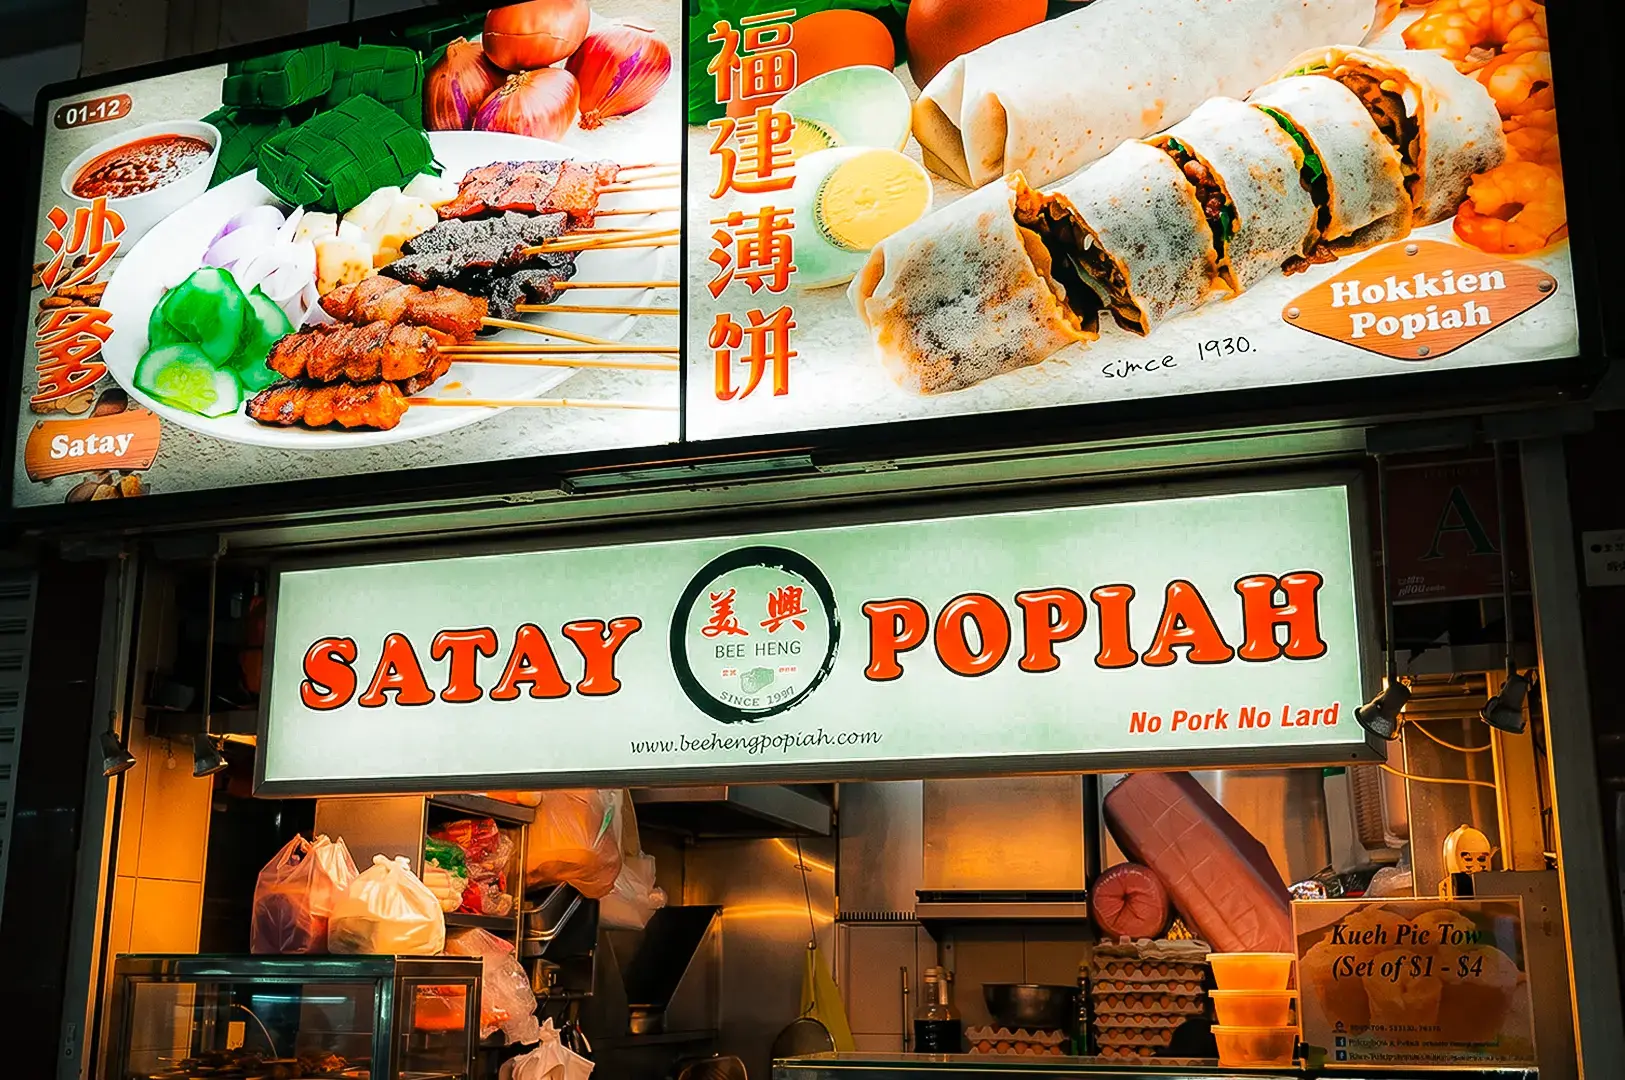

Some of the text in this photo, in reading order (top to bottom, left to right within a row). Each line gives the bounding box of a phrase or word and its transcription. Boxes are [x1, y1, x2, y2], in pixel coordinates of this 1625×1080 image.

[66, 99, 120, 126] 01-12
[707, 8, 798, 401] 福建薄饼
[30, 196, 128, 404] 沙爹
[1330, 269, 1507, 308] Hokkien
[1349, 300, 1493, 341] Popiah
[1198, 336, 1257, 361] 1930.
[50, 431, 135, 459] Satay
[1417, 484, 1504, 562] A
[701, 585, 808, 637] 美興
[861, 569, 1328, 683] POPIAH
[300, 616, 643, 711] SATAY
[715, 640, 801, 659] BEE HENG
[720, 690, 760, 707] SINCE
[1129, 703, 1340, 733] No Pork No Lard
[630, 727, 882, 756] www.beehengpopiah.com
[1330, 923, 1388, 946] Kueh
[1332, 955, 1375, 981] (Set
[1380, 954, 1408, 982] of
[1409, 955, 1433, 979] $1
[1456, 954, 1483, 978] $4
